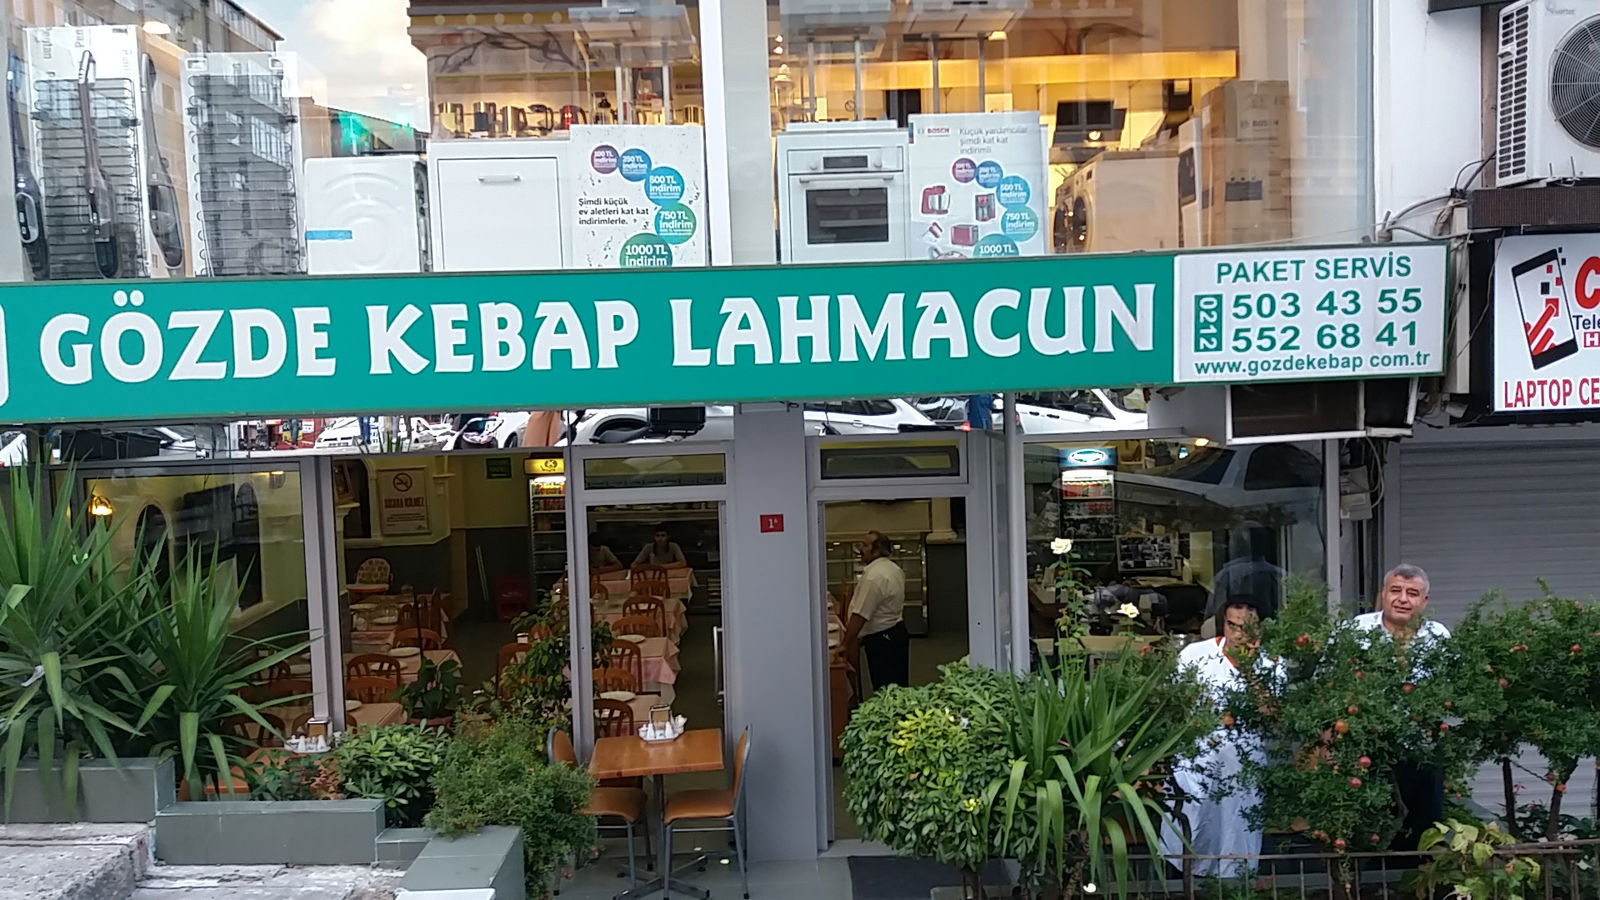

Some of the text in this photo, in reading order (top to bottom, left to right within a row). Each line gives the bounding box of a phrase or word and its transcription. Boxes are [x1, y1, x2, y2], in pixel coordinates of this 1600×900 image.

[649, 175, 676, 184] 500 TL
[649, 184, 681, 193] indirim
[578, 197, 628, 207] Şimdi küçük
[590, 207, 619, 216] aletleri
[621, 207, 634, 216] kat
[636, 207, 649, 216] kat
[660, 210, 688, 220] 750 TL
[1006, 212, 1030, 220] 750 TL
[578, 217, 629, 226] indirimlerle.
[659, 220, 693, 230] indirim
[1006, 220, 1035, 228] indirim
[625, 244, 668, 256] 1000 TL
[979, 244, 1015, 254] 1000 TL
[625, 255, 668, 267] indirim
[1216, 251, 1412, 284] PAKET SERVİS
[1231, 288, 1423, 320] 503 43 55
[1199, 297, 1218, 349] 0212
[40, 282, 1157, 385] GÖZDE KEBAP LAHMACUN
[1231, 320, 1417, 353] 552 68 41
[1504, 377, 1600, 408] LAPTOP CE
